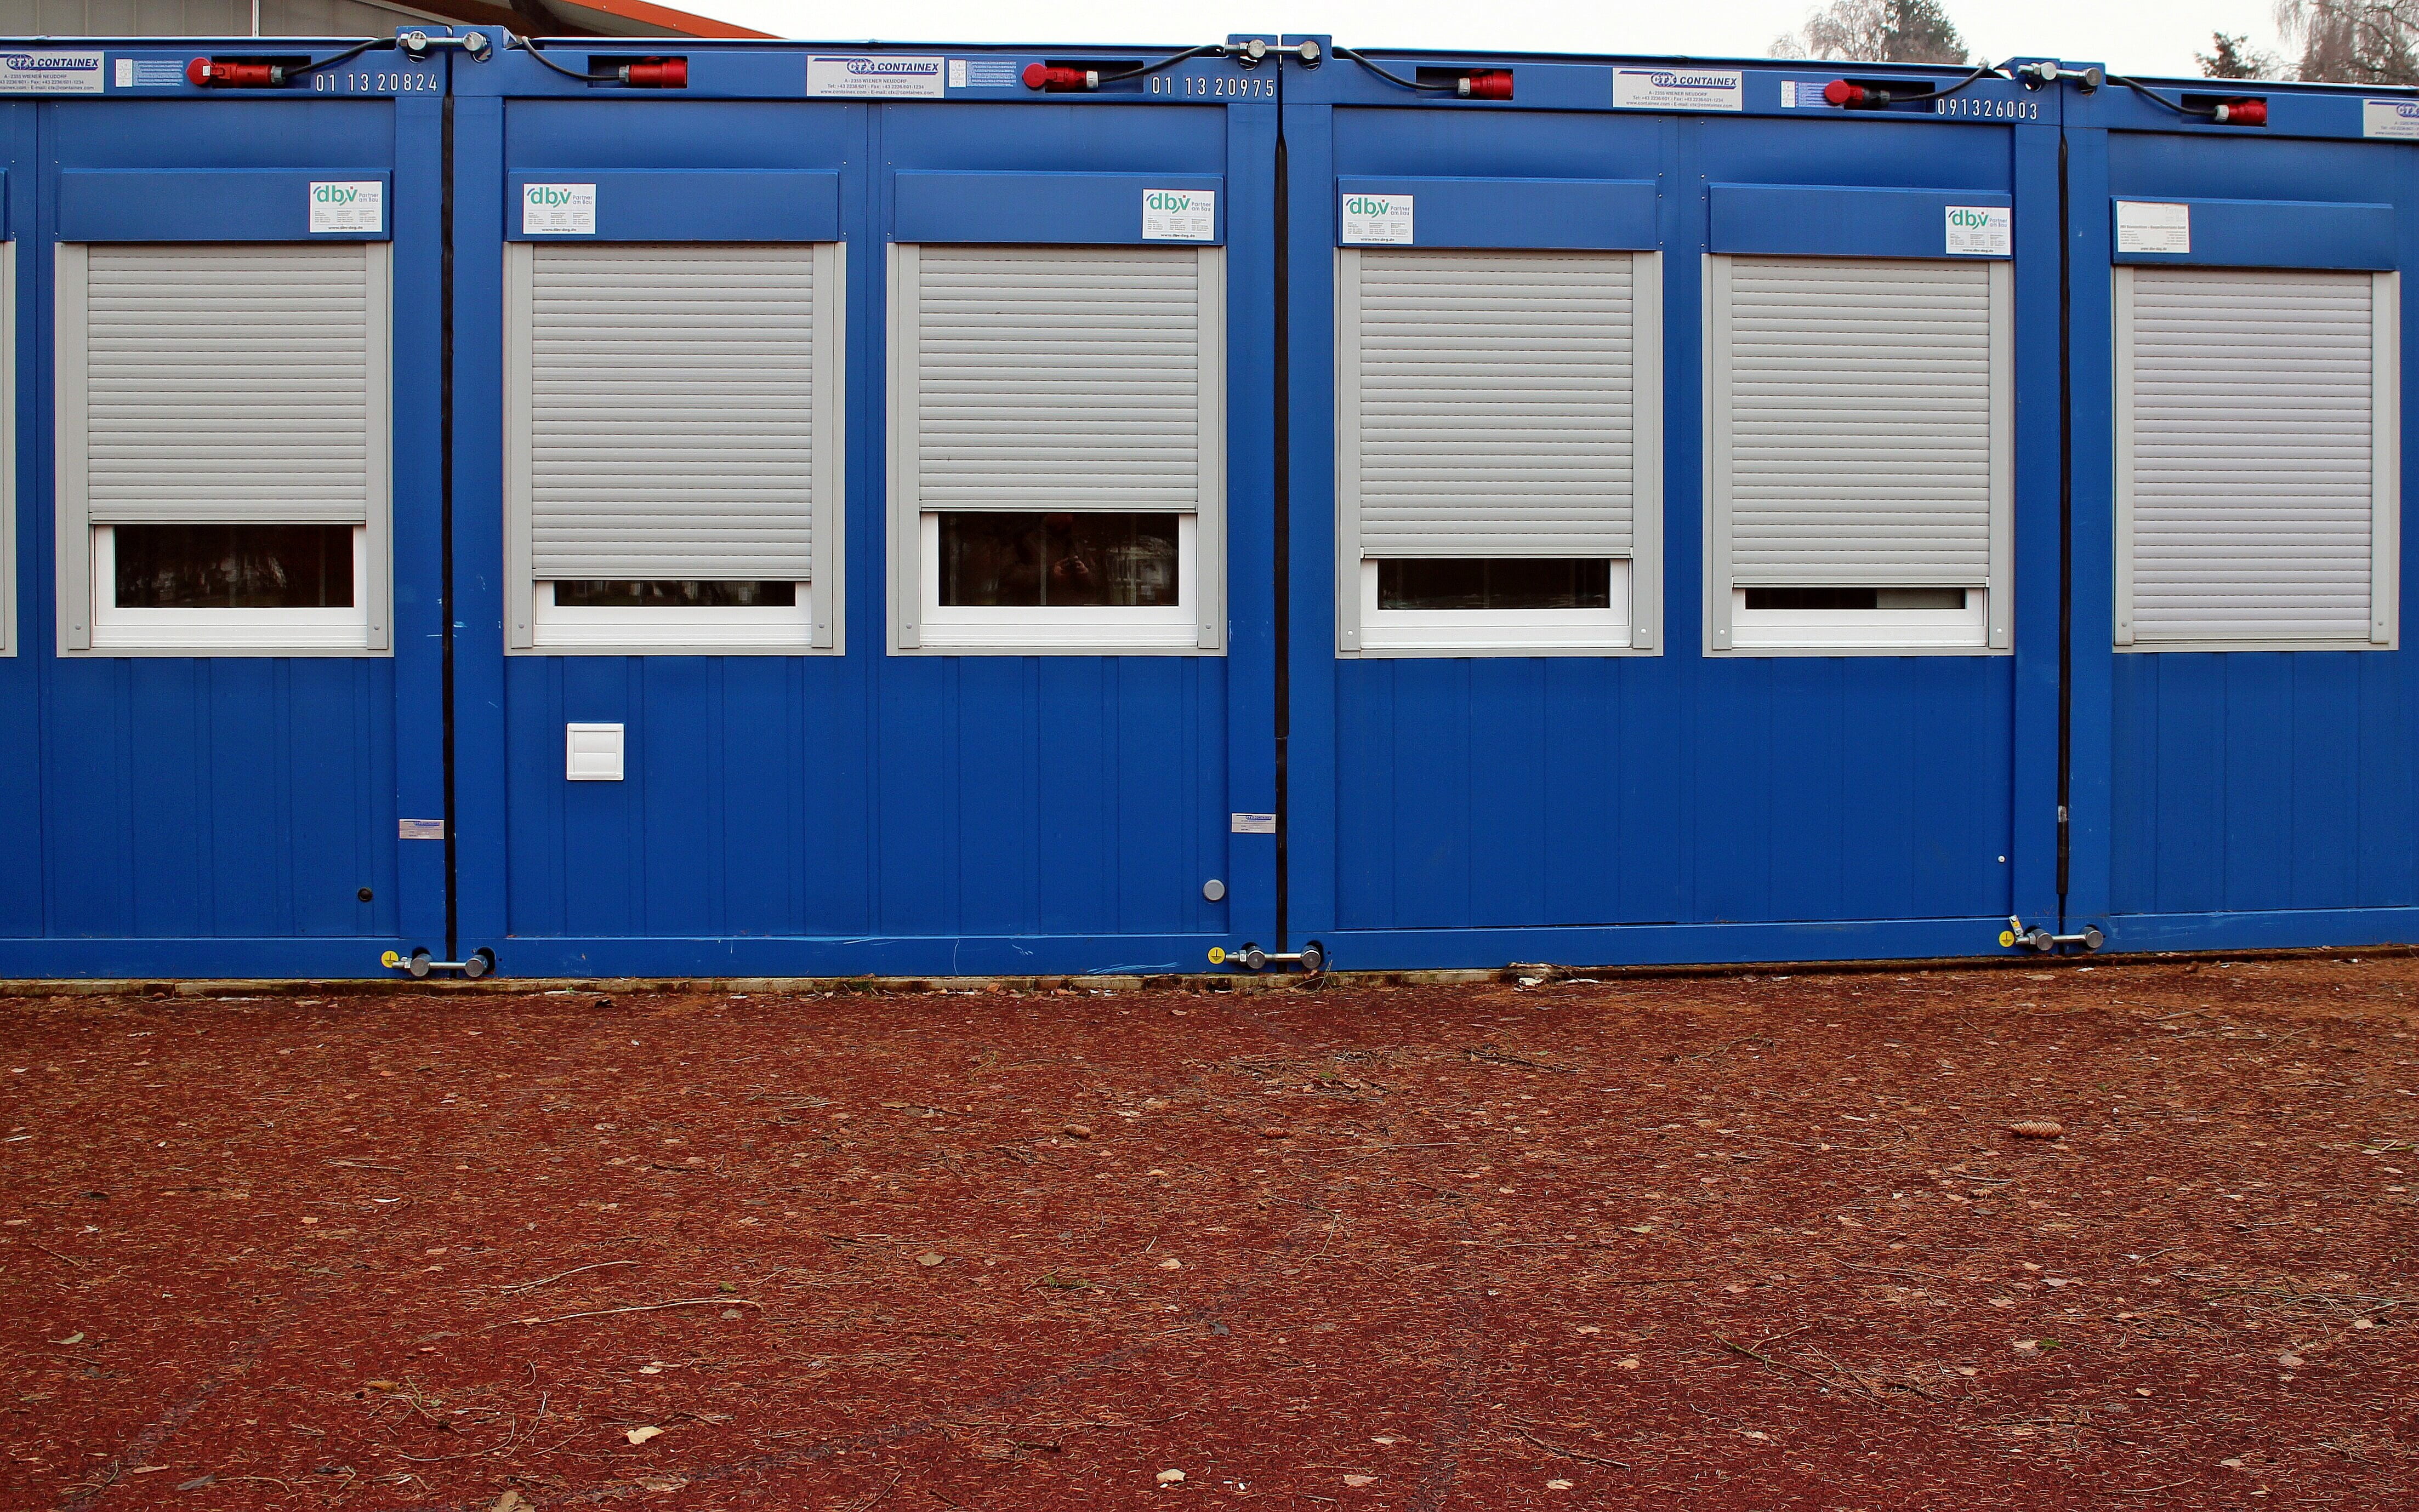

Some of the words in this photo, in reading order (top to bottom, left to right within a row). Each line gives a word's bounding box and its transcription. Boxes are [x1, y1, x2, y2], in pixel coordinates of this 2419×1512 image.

[7, 56, 33, 69] CTX
[38, 58, 99, 67] CONTAINEX
[848, 60, 874, 72] CTX
[878, 62, 939, 72] CONTAINEX
[316, 73, 335, 92] 01
[349, 73, 368, 92] 13
[378, 73, 437, 92] 20824
[1152, 77, 1171, 95] 01
[1186, 77, 1205, 95] 13
[1215, 78, 1274, 97] 20975
[1652, 73, 1676, 85] CTX
[1680, 76, 1737, 85] CONTAINEX
[1937, 99, 2037, 119] 091326003
[2398, 105, 2419, 116] CTX
[315, 185, 358, 203] dbv
[529, 187, 572, 206] dbv
[1148, 193, 1191, 211] dbv
[1348, 198, 1390, 216] dbv
[1950, 210, 1989, 227] dbv
